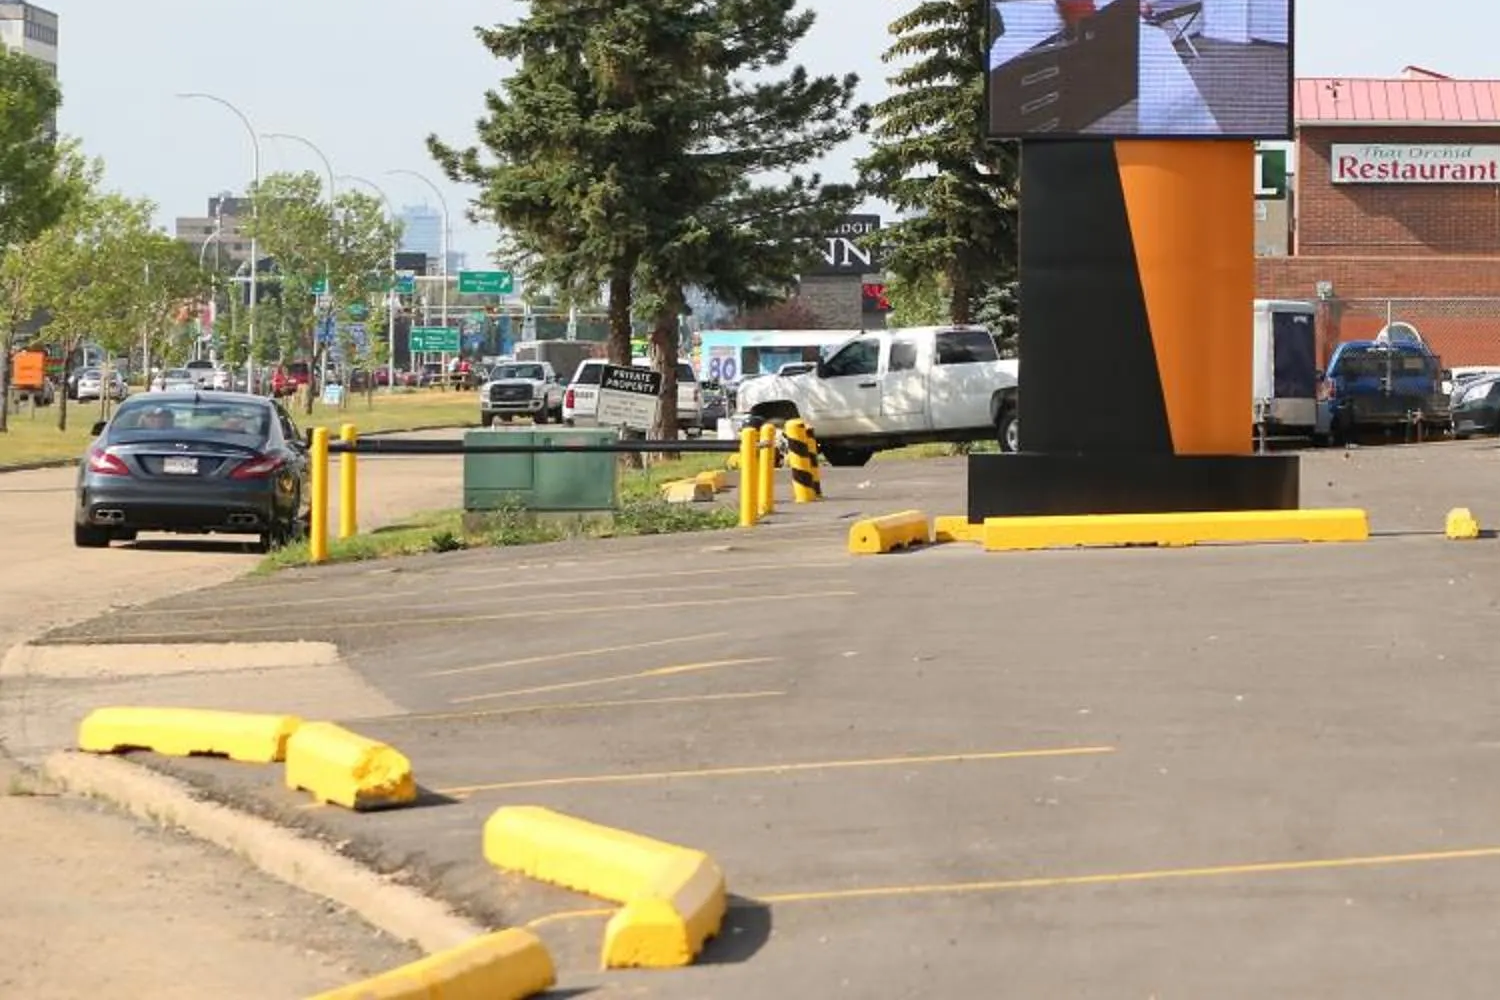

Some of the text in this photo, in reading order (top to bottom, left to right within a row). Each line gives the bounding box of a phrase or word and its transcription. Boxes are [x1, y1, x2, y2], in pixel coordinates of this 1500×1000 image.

[1360, 146, 1473, 158] Thai Orchid
[1338, 155, 1497, 180] Restaurant
[612, 369, 652, 382] PRIVATE
[605, 377, 655, 393] PROPERTY
